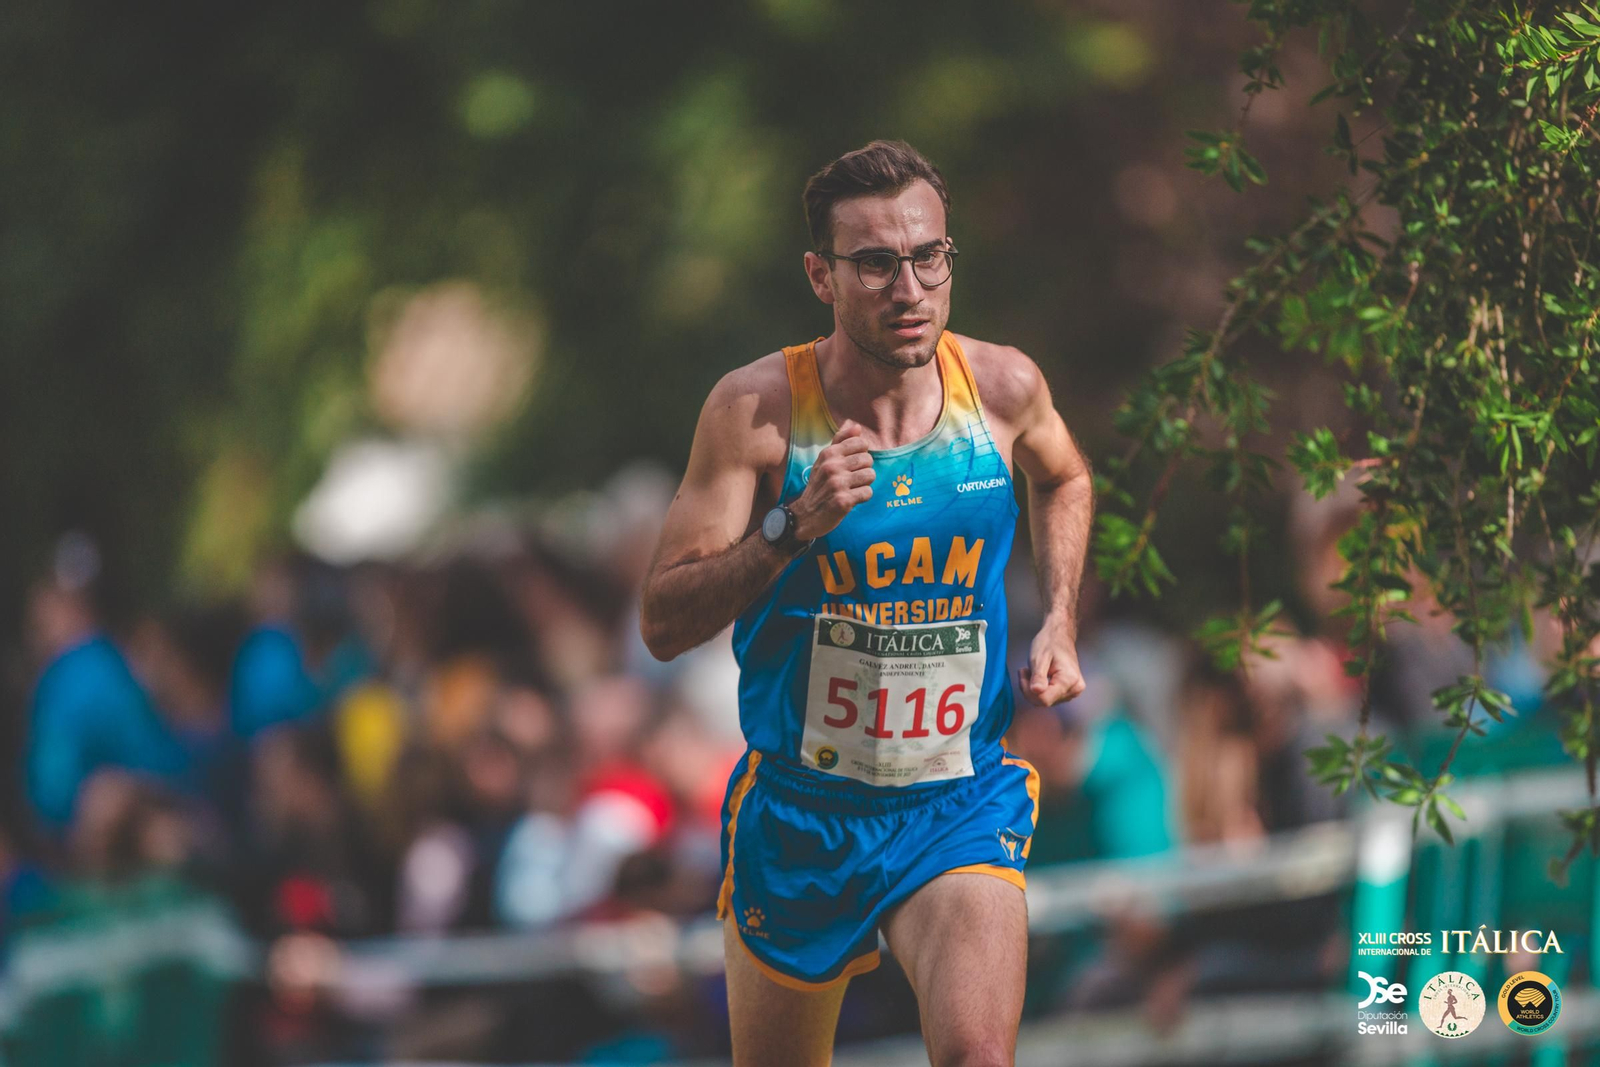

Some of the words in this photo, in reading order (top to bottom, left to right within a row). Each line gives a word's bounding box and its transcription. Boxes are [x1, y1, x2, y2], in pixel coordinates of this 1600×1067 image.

[956, 477, 1007, 493] CARTAGENA
[886, 496, 923, 508] KELME
[816, 535, 985, 595] UCAM
[866, 630, 945, 652] ITÁLICA
[922, 660, 946, 669] DANIEL
[823, 676, 966, 739] 5116
